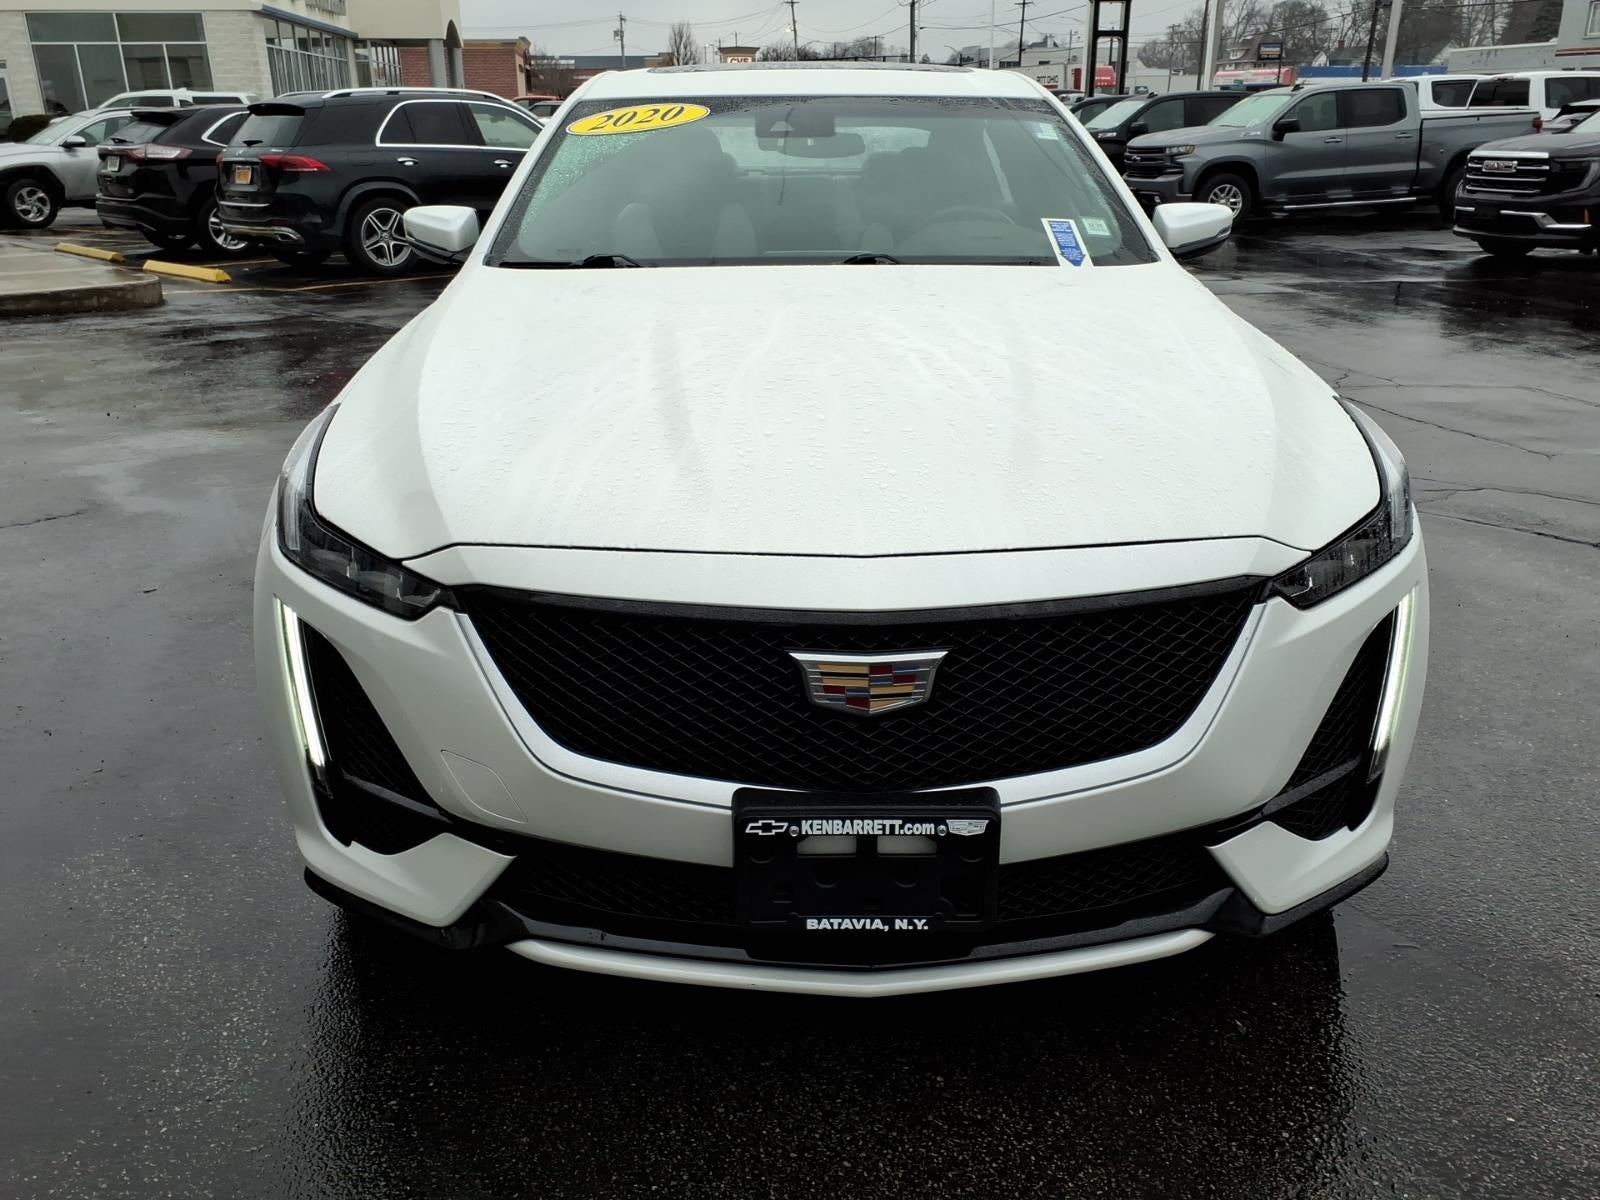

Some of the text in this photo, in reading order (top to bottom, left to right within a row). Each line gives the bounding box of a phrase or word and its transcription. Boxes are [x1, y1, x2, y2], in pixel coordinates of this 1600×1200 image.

[587, 106, 685, 132] 2020
[801, 819, 935, 836] KENBARRETT.com
[806, 919, 929, 932] BATAVIA, N.Y.
